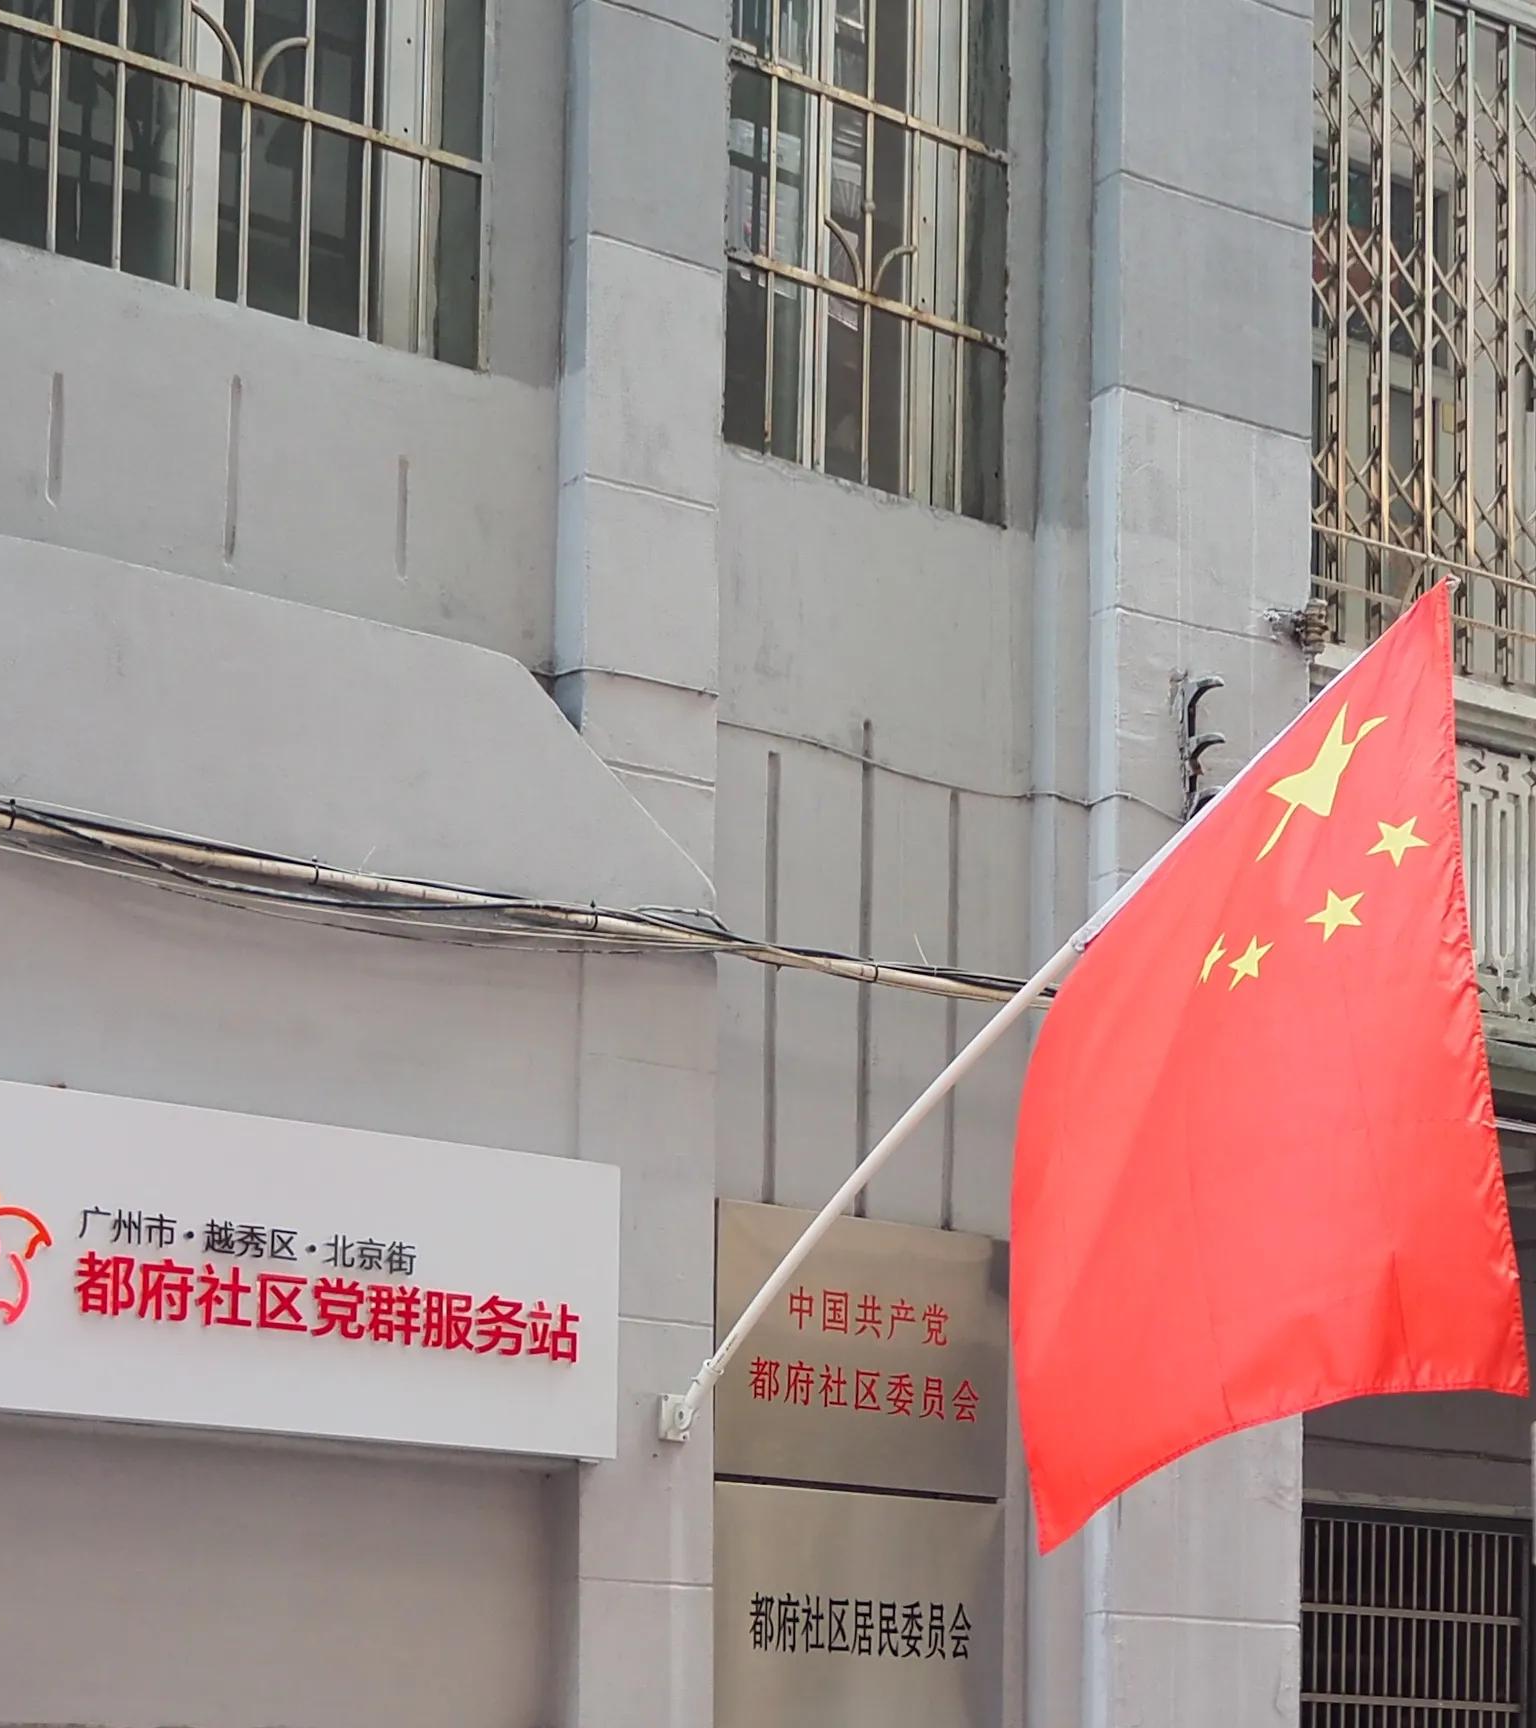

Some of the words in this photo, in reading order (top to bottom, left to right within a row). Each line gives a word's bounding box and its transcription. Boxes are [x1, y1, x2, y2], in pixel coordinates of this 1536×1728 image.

[76, 1251, 581, 1364] 都府社区党群服务站
[789, 1286, 950, 1347] 中国共产党
[749, 1356, 980, 1423] 都府社区委员会
[749, 1592, 972, 1660] 都府社区居民委员会
